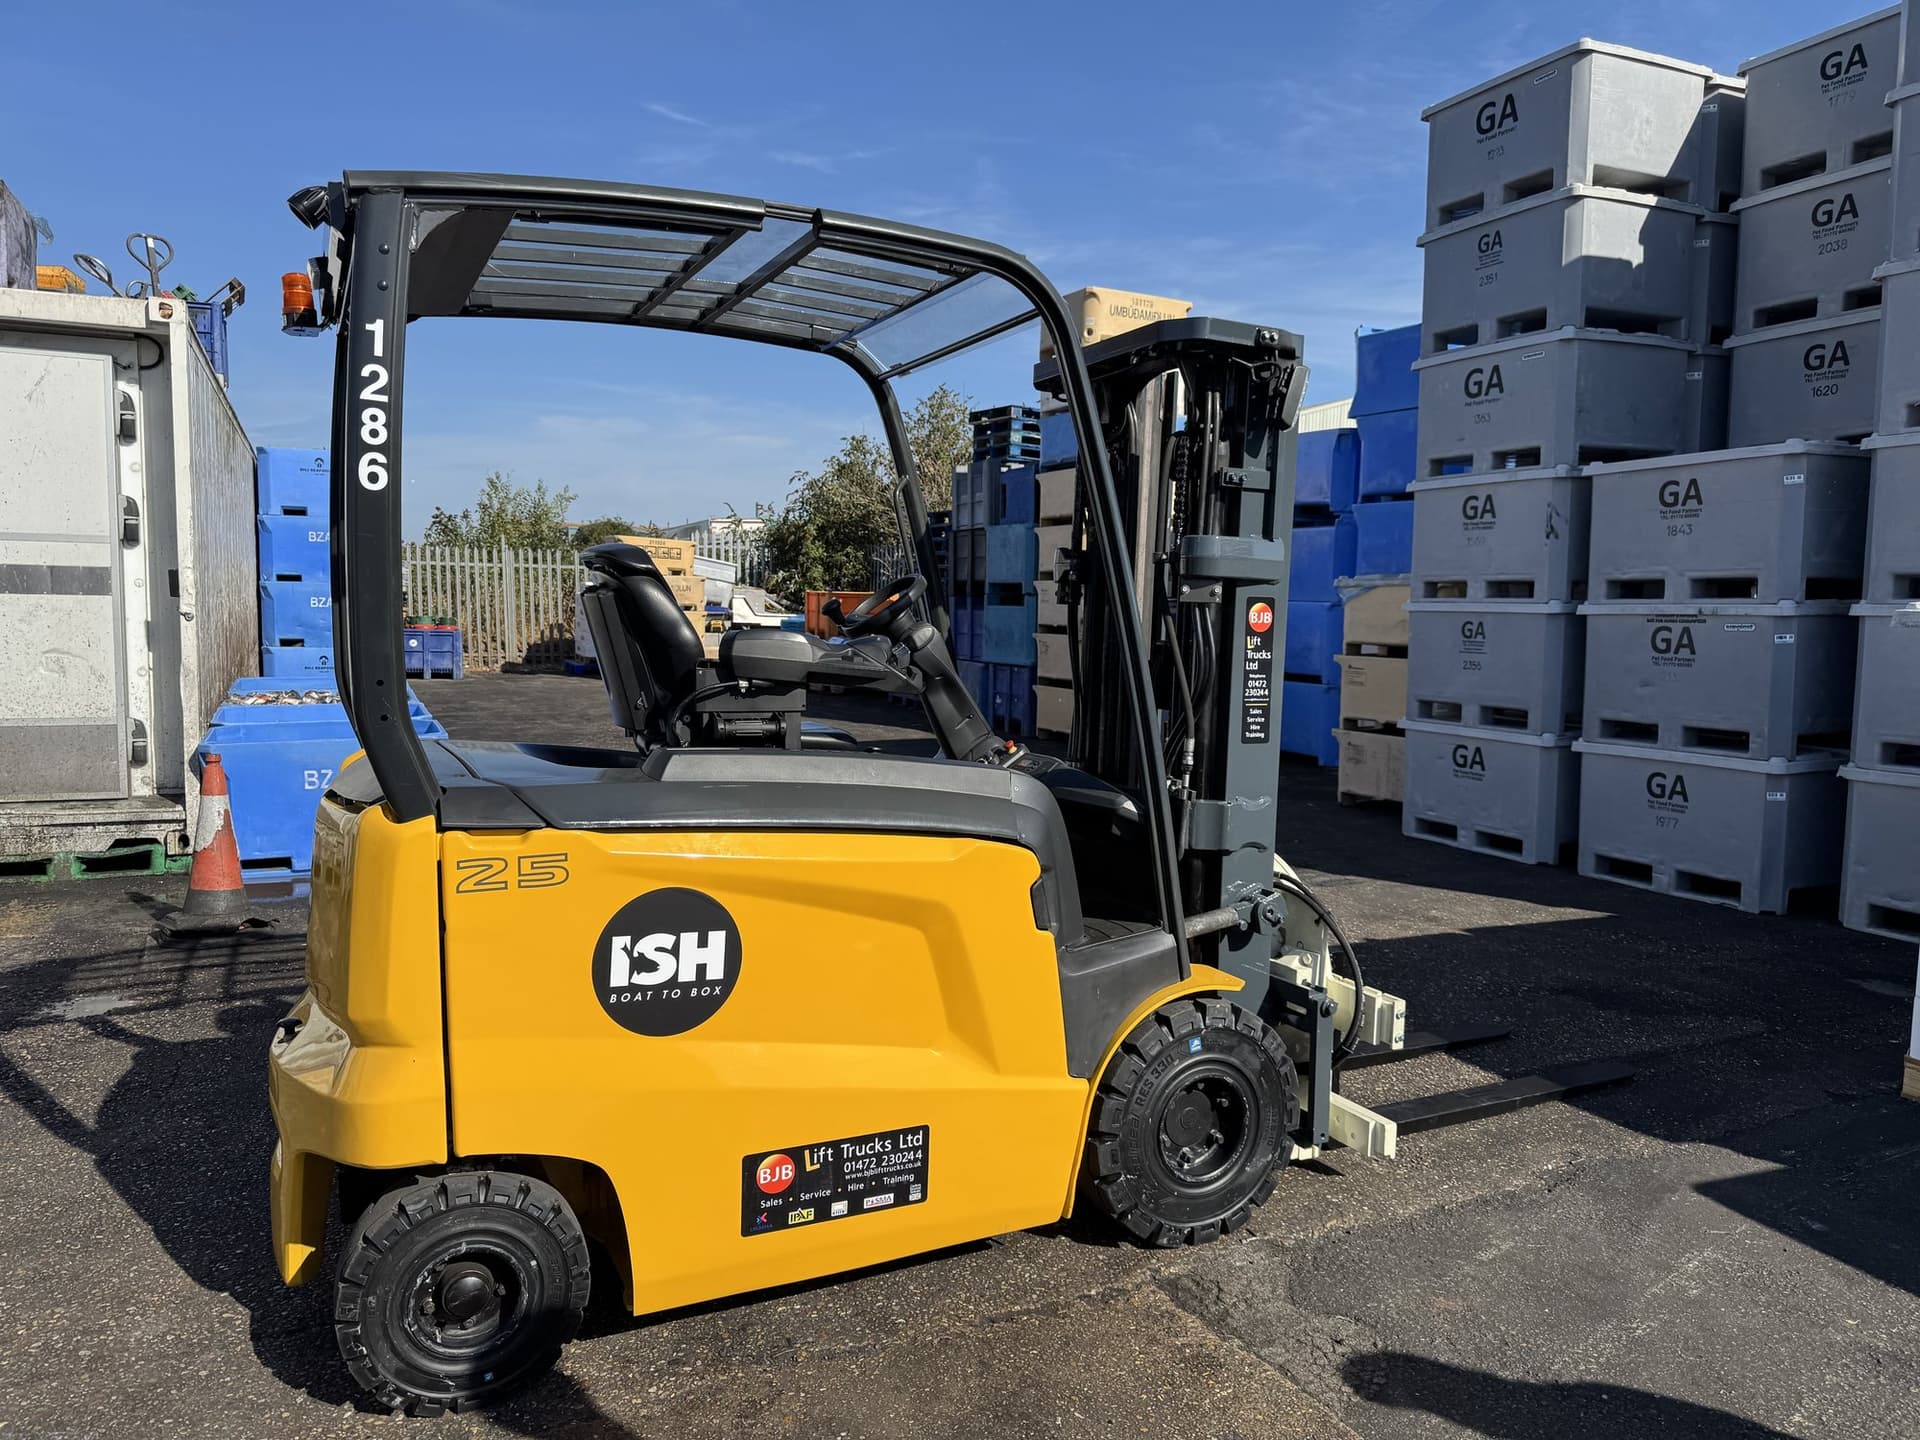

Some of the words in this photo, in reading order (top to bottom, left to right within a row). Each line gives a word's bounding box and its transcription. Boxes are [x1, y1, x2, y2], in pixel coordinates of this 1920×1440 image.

[1820, 43, 1868, 81] GA
[1476, 93, 1519, 135] GA
[1811, 193, 1859, 227] GA
[1478, 230, 1503, 254] GA
[1818, 239, 1848, 256] 2038
[1803, 340, 1850, 371] GA
[1464, 364, 1504, 399] GA
[1811, 383, 1839, 398] 1620
[358, 318, 389, 491] 1286
[1659, 478, 1703, 508] GA
[1462, 494, 1496, 520] GA
[1666, 523, 1693, 536] 1843
[1251, 612, 1272, 623] BJB
[1462, 621, 1486, 640] GA
[1247, 636, 1261, 649] Lift
[1650, 626, 1696, 655] GA
[1246, 650, 1271, 659] Trucks
[1246, 661, 1258, 670] Ltd
[1245, 688, 1269, 696] 230244
[1452, 744, 1485, 771] GA
[1647, 772, 1689, 803] GA
[456, 852, 569, 894] 25
[609, 930, 727, 988] ISH
[609, 991, 653, 1004] BOAT
[662, 989, 681, 999] TO
[690, 986, 722, 997] BOX
[1135, 1078, 1156, 1108] RES
[804, 1146, 833, 1172] Lift
[840, 1137, 892, 1159] Trucks
[899, 1130, 923, 1149] Ltd
[843, 1157, 877, 1173] 01472
[881, 1149, 922, 1167] 230244
[760, 1164, 793, 1184] BJB
[845, 1160, 922, 1180] www.bjblifttrucks.co.uk
[760, 1198, 783, 1209] Sales
[799, 1189, 832, 1201] Service
[847, 1182, 865, 1192] Hire
[882, 1173, 915, 1185] Training
